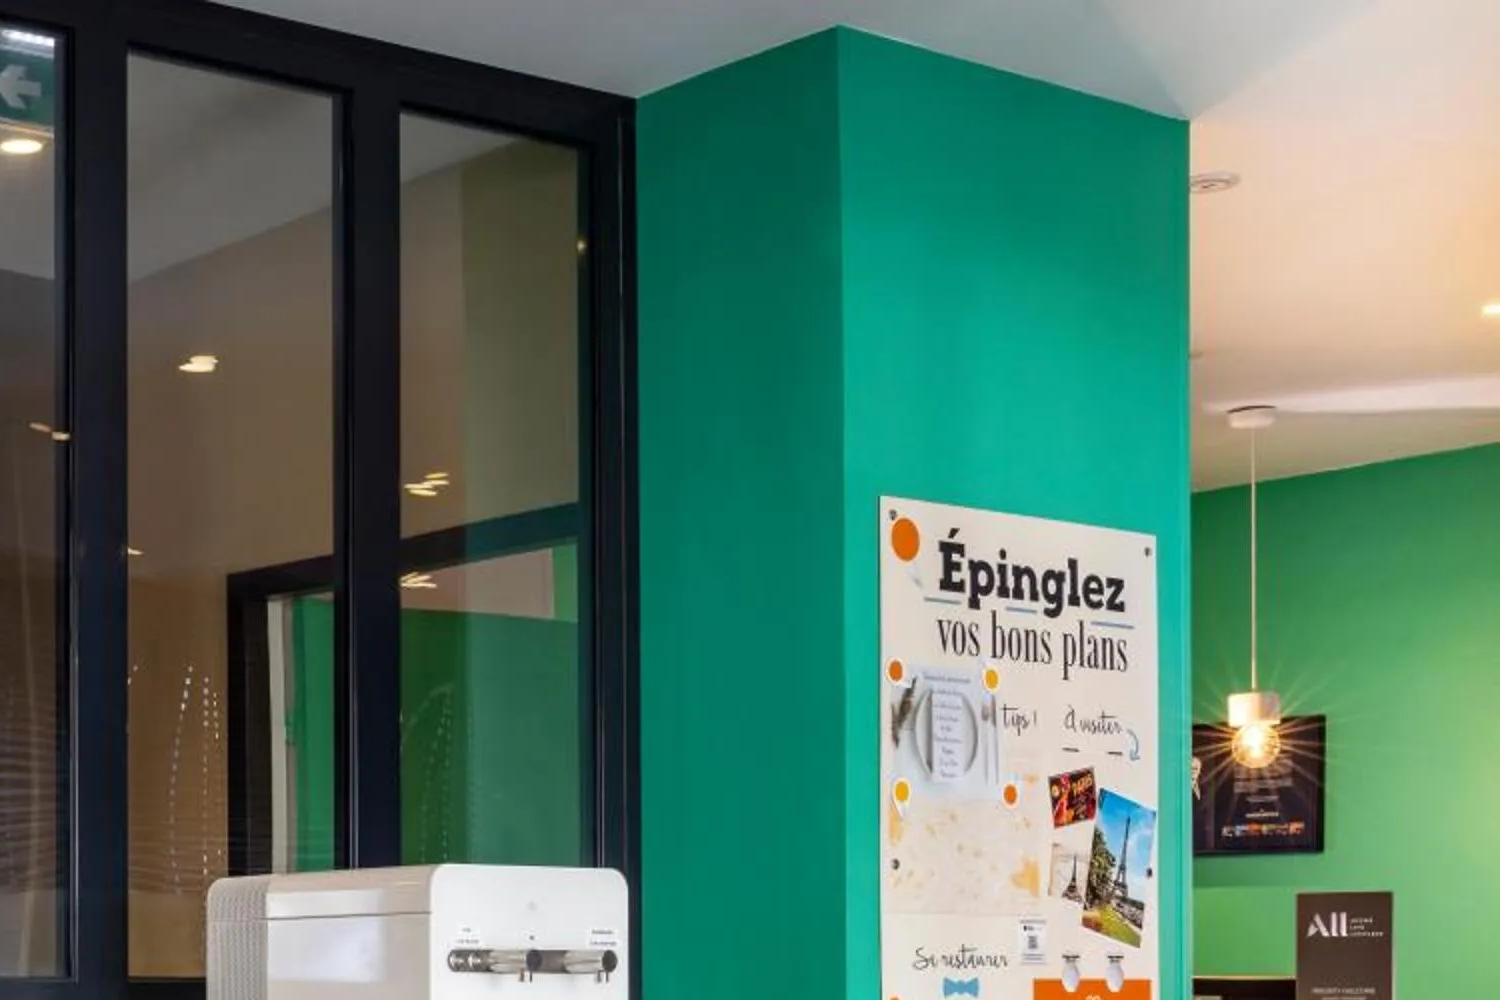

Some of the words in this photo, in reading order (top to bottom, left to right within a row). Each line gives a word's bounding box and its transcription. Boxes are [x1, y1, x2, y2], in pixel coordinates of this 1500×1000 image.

[938, 528, 1125, 618] Épinglez
[937, 619, 981, 656] vos
[991, 610, 1053, 666] bons
[1063, 620, 1128, 681] plans
[941, 944, 1008, 969] restaurer
